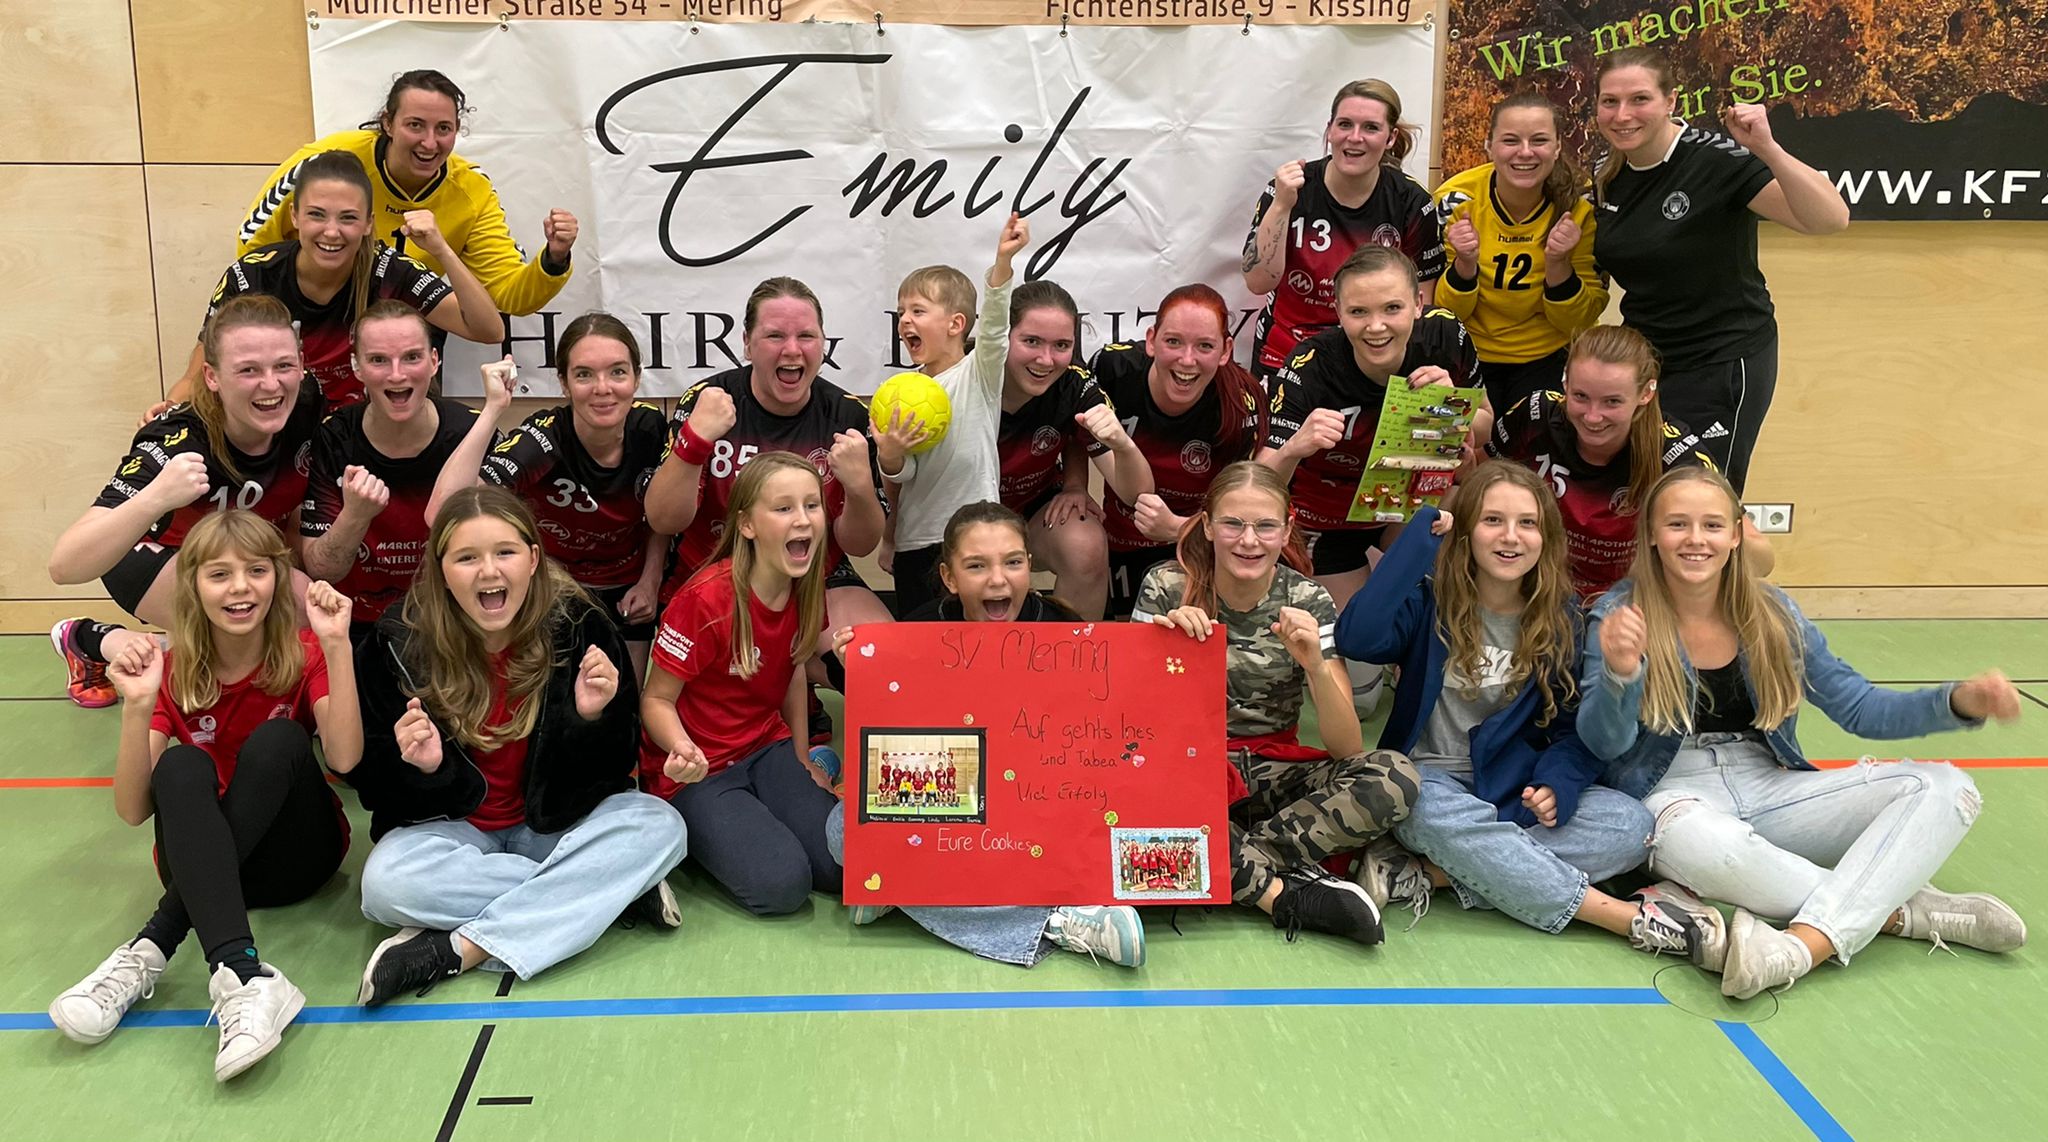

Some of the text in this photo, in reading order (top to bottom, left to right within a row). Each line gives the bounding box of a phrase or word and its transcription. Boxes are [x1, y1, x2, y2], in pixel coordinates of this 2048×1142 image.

[614, 0, 647, 15] 54
[1478, 0, 1789, 82] Wir machen
[1729, 58, 1824, 104] Sie.
[596, 52, 1131, 283] Emily
[1291, 216, 1333, 252] 13
[1492, 252, 1533, 291] 12
[502, 310, 743, 371] HIR
[1339, 405, 1362, 441] 7
[710, 439, 759, 479] 85
[1535, 453, 1571, 498] 15
[209, 480, 264, 512] 10
[546, 477, 600, 513] 33
[376, 541, 418, 550] MARKT
[940, 628, 1111, 701] SV Mering
[1010, 706, 1156, 750] Auf gehts Ines
[1039, 751, 1118, 768] und Tabea
[1056, 781, 1108, 812] Erfolg
[937, 827, 1033, 852] Eure Cookies
